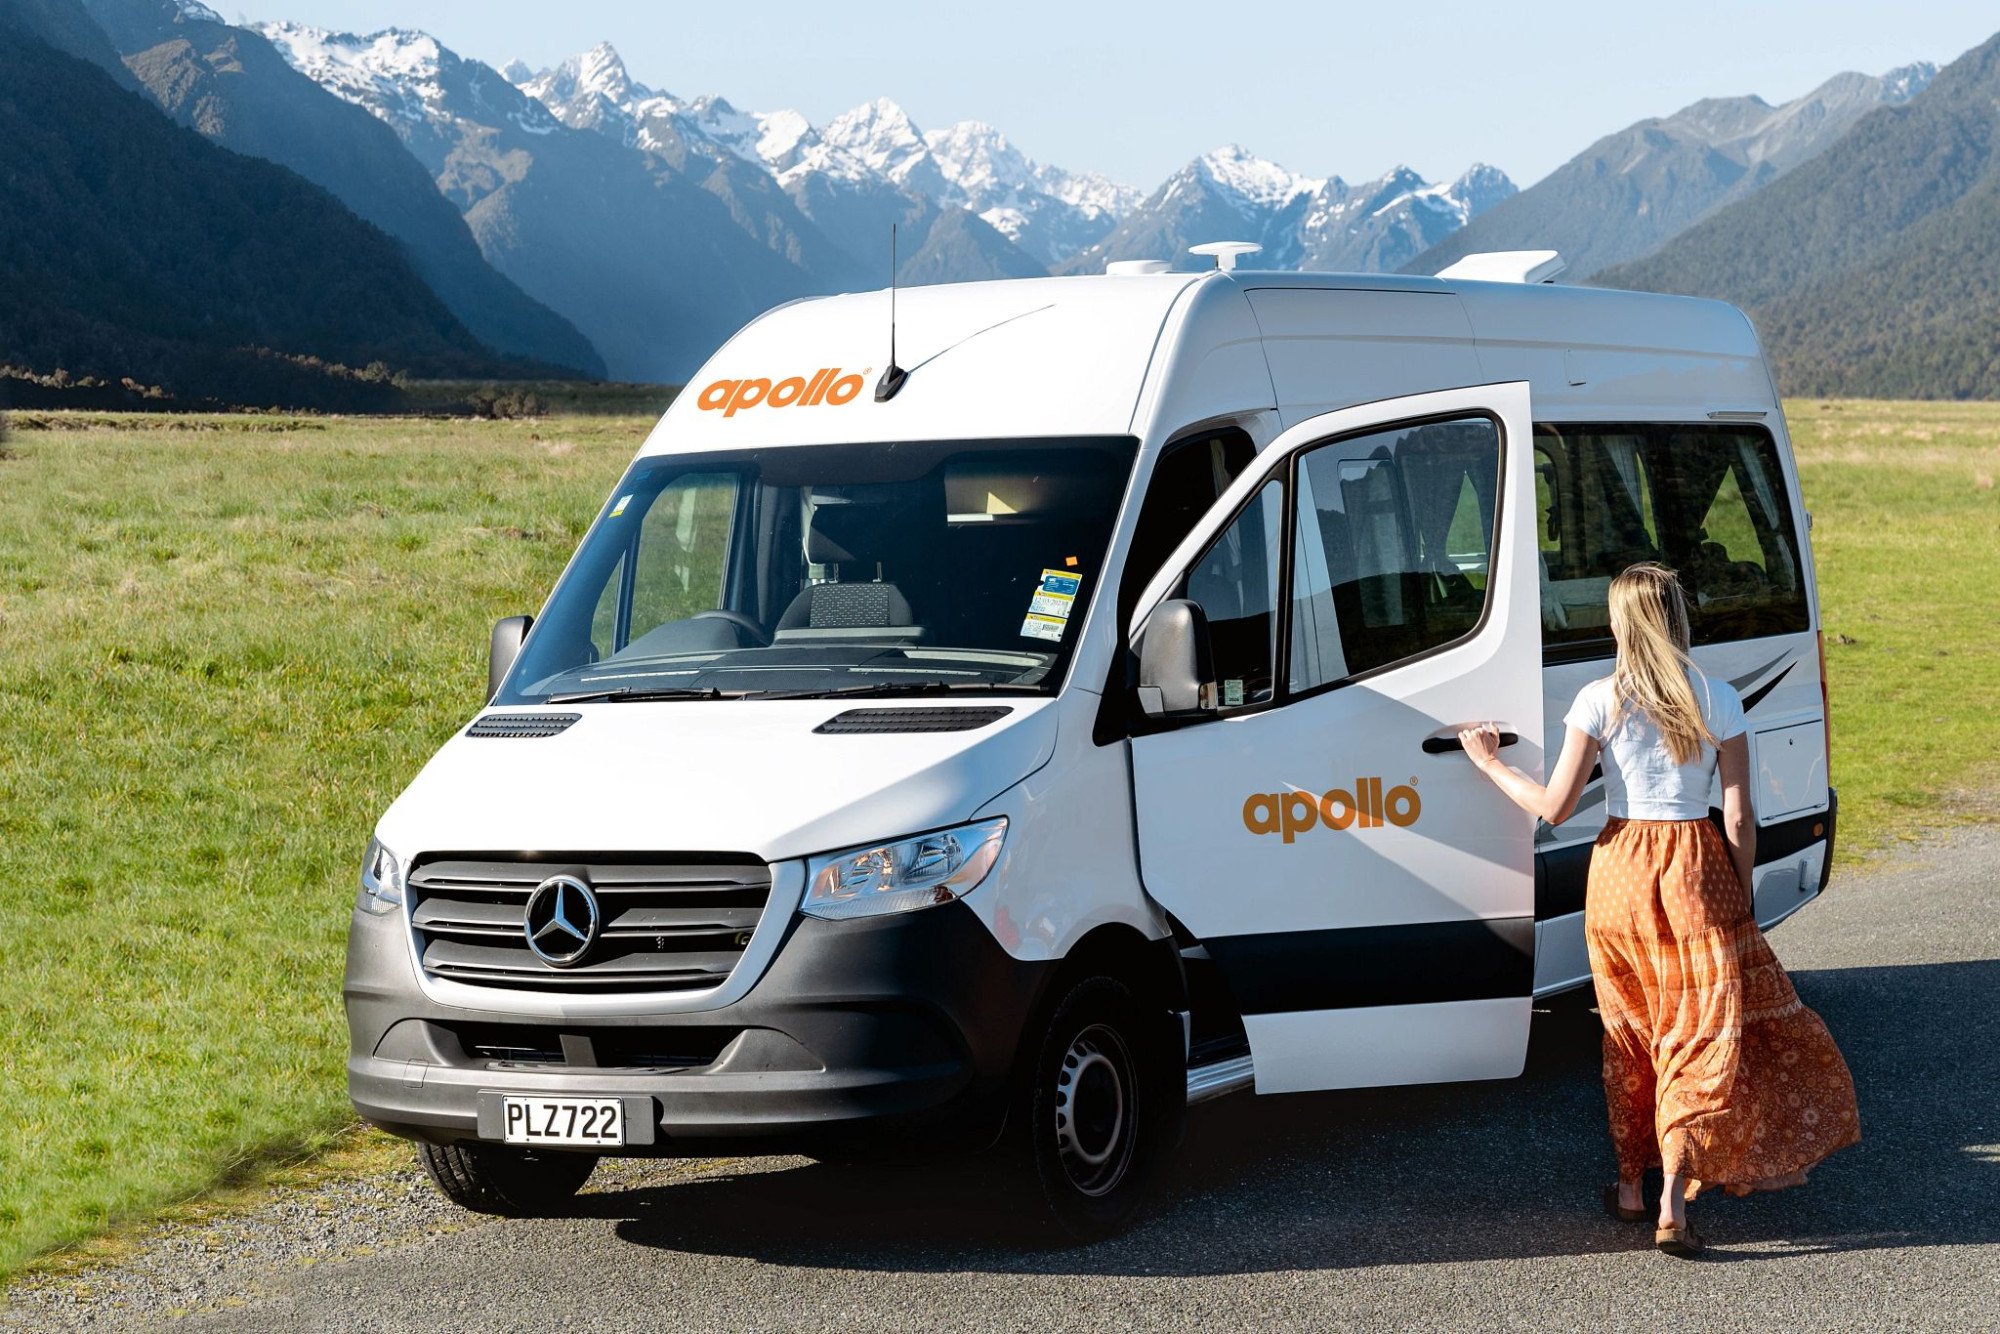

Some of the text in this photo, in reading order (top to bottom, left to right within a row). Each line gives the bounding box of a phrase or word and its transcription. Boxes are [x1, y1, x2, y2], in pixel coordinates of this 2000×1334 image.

[697, 368, 864, 417] apollo
[1243, 777, 1421, 844] apollo
[507, 1103, 618, 1139] PLZ722
